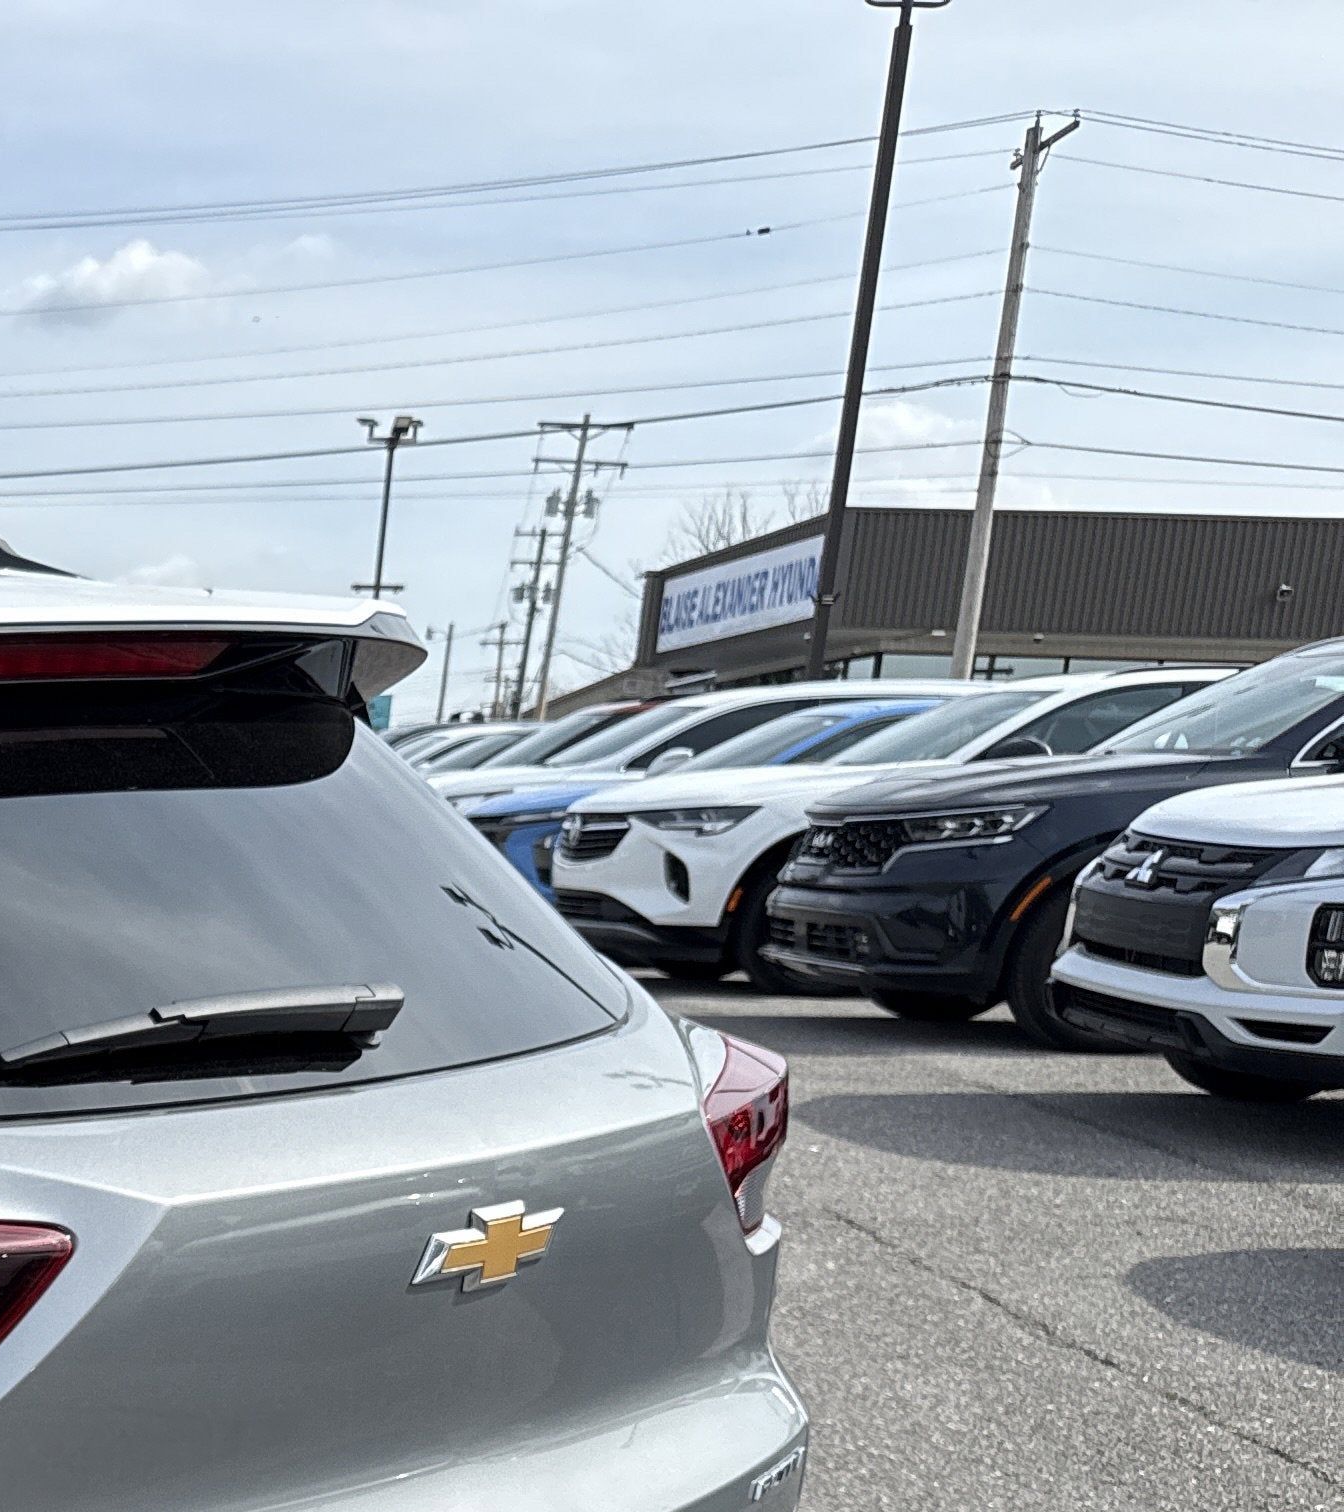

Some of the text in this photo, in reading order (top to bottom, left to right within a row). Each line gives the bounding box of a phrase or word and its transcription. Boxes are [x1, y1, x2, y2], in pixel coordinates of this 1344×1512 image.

[660, 556, 818, 635] BLAISE ALEXANDER HYUND
